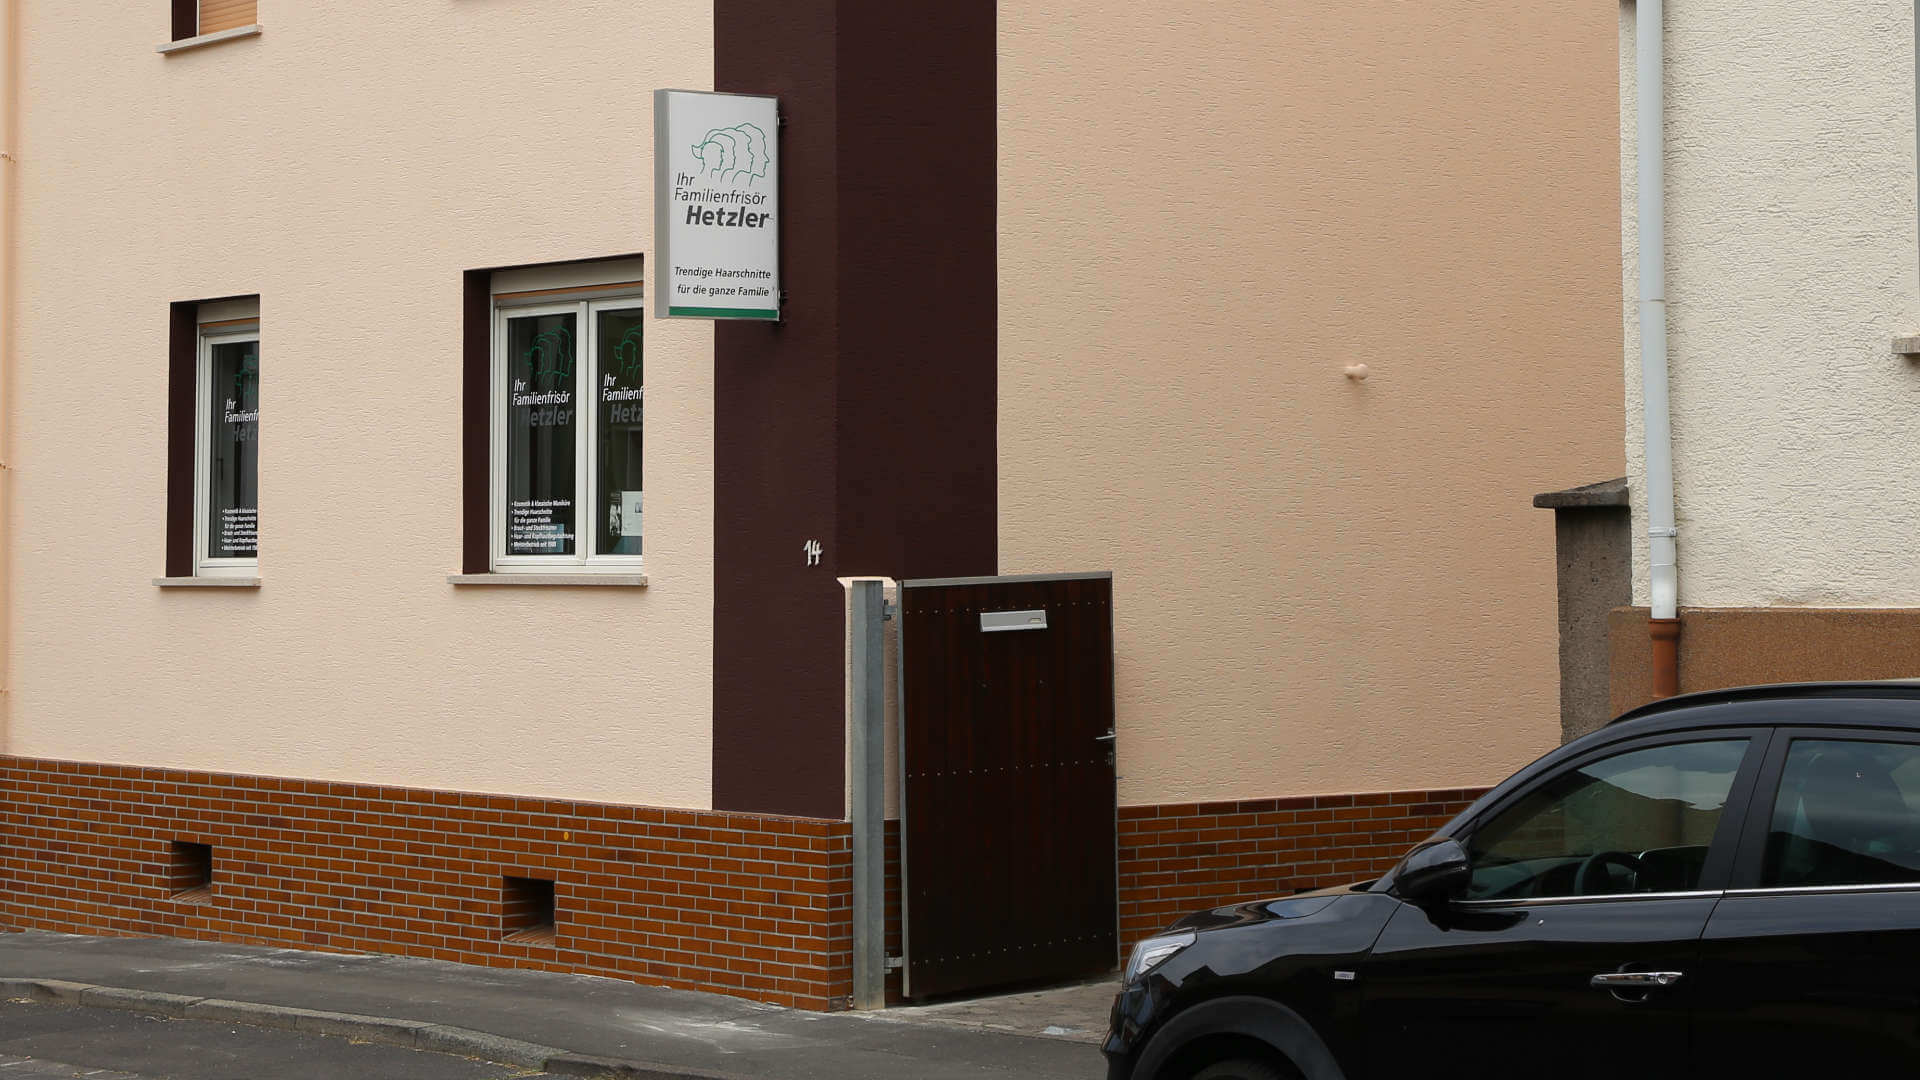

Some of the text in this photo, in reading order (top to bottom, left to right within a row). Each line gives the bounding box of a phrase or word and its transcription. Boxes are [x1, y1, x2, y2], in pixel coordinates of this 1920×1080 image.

[676, 171, 695, 186] Ihr
[675, 187, 767, 205] Familienfrisör
[686, 205, 769, 228] Hetzler
[675, 266, 771, 279] Trendige Haarschnitte
[677, 283, 769, 297] für die ganze Familie
[514, 378, 526, 391] Ihr
[603, 373, 616, 387] Ihr
[512, 390, 570, 406] Familienfrisör
[602, 386, 643, 402] Familienf
[226, 398, 236, 410] Ihr
[803, 539, 824, 566] 14
